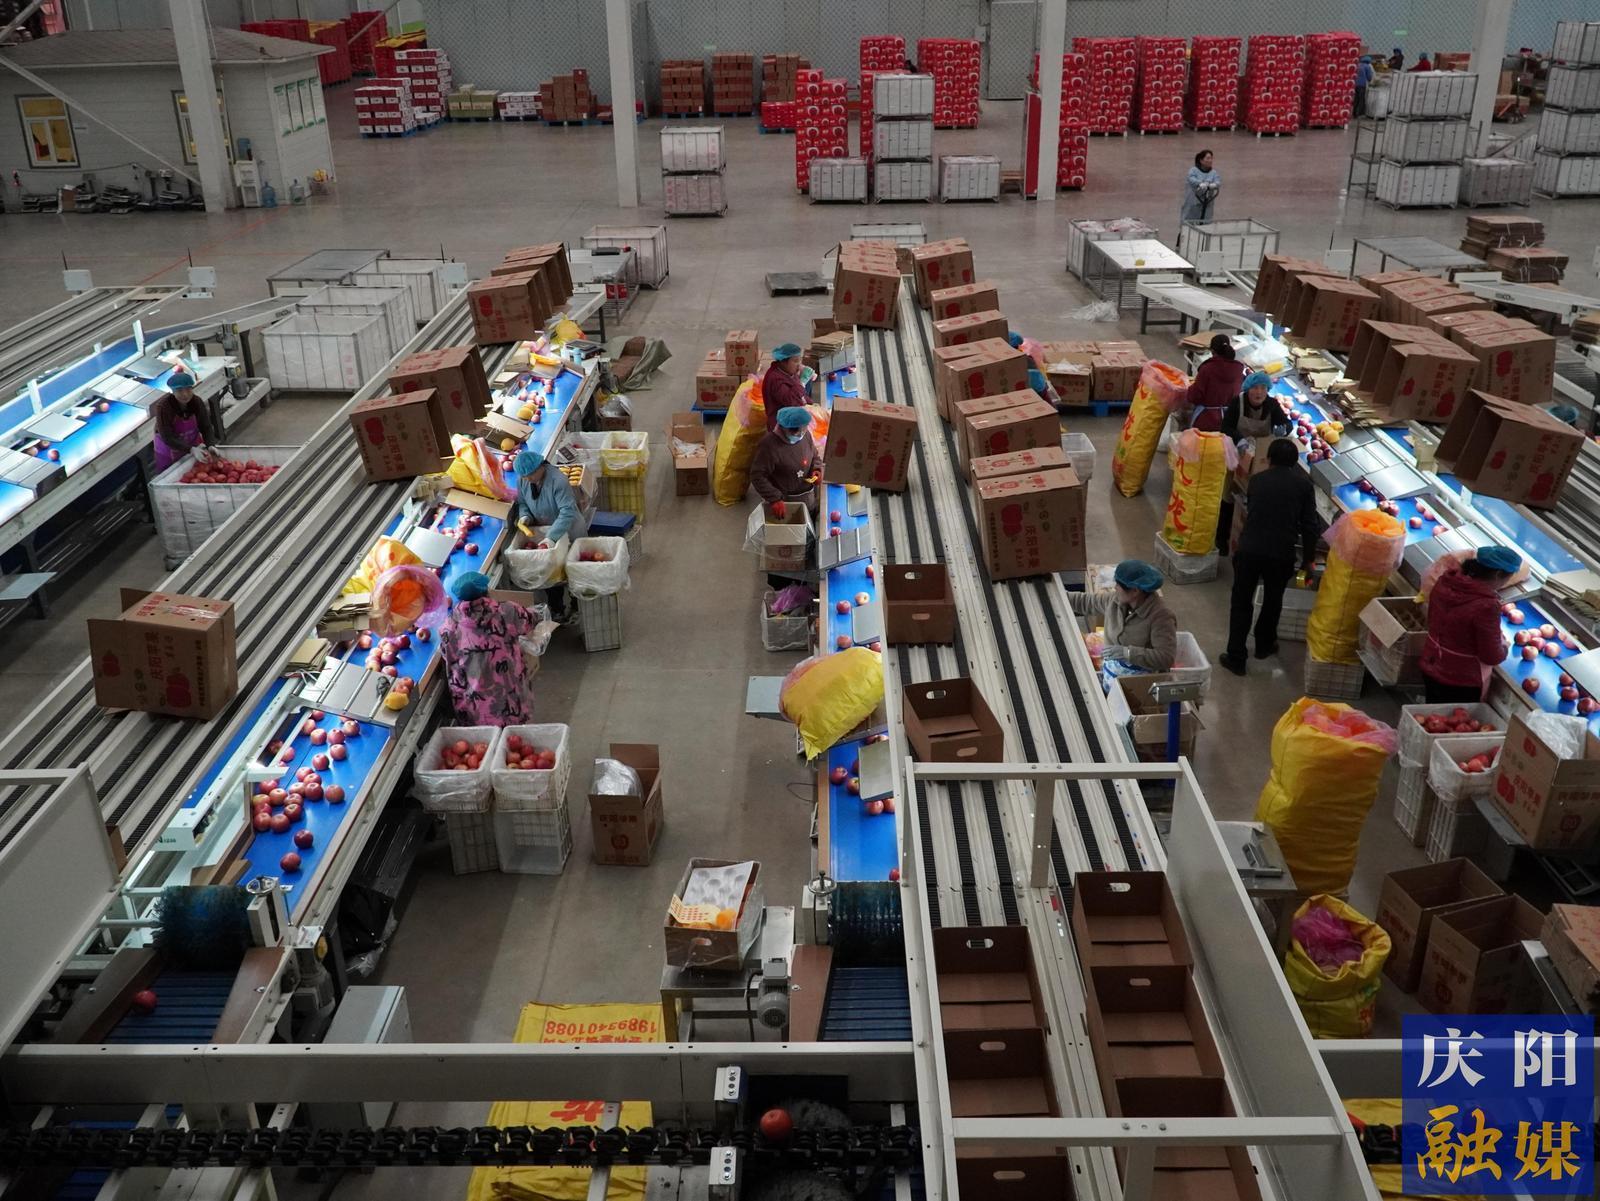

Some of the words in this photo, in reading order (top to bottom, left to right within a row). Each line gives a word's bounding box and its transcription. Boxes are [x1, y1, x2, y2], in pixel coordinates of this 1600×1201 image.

[386, 435, 406, 473] 庆阳苹果
[865, 421, 882, 461] 庆阳苹果
[1529, 431, 1554, 477] 庆阳苹果
[1024, 525, 1041, 569] 庆阳苹果
[144, 631, 164, 681] 庆阳苹果
[1513, 774, 1542, 808] 庆阳苹果
